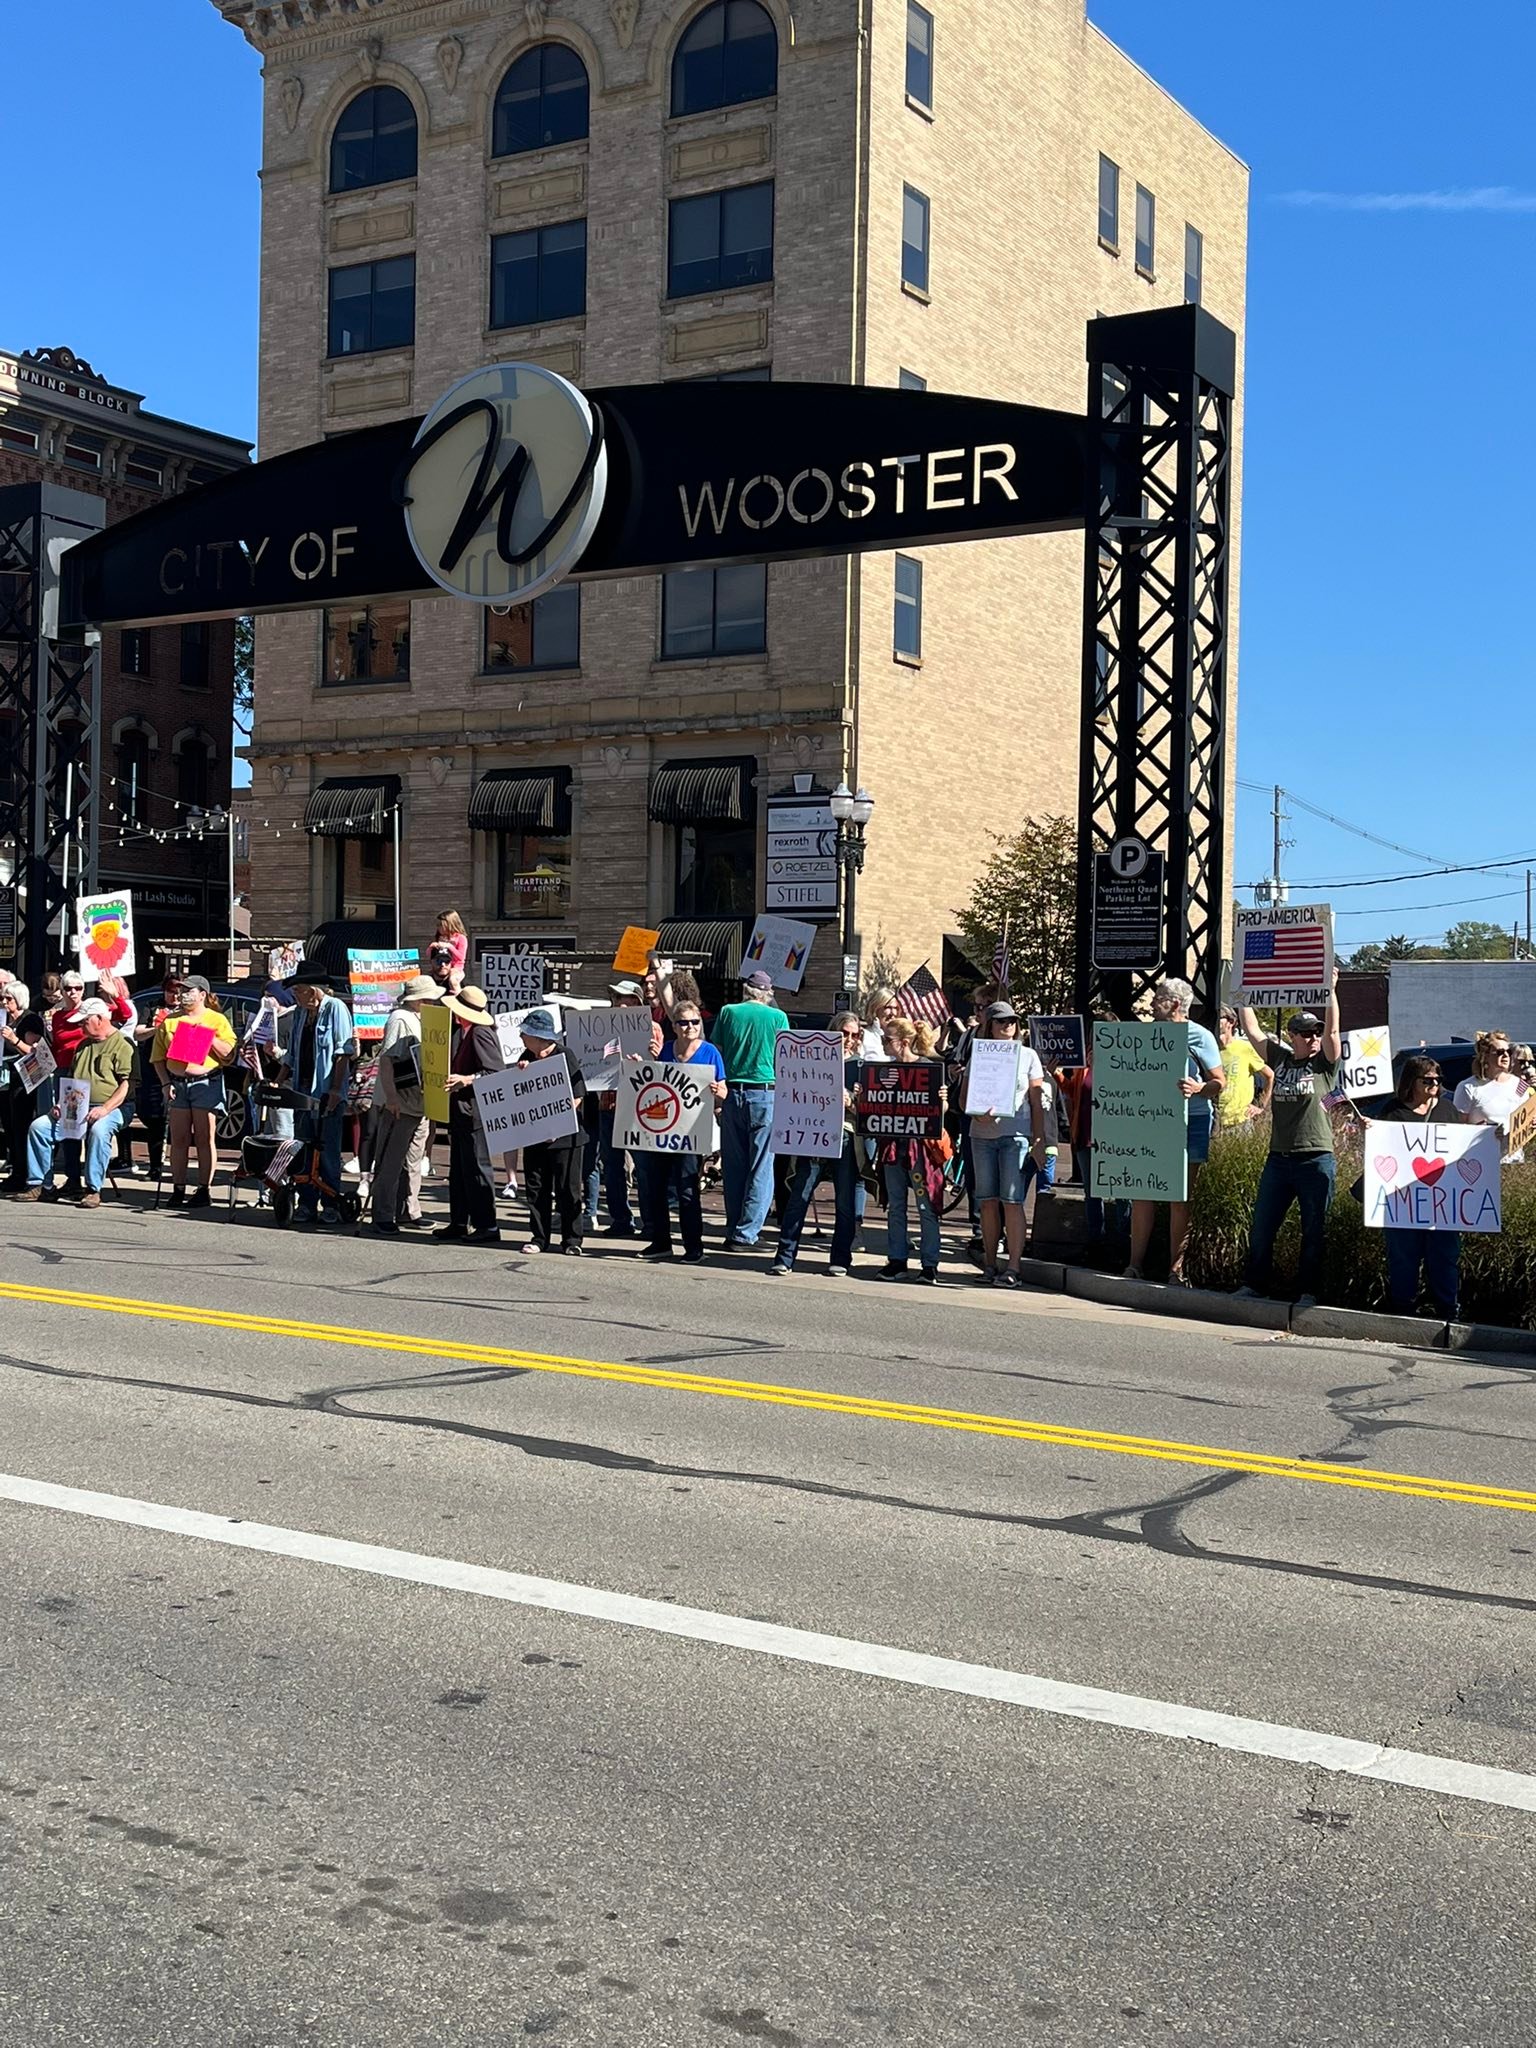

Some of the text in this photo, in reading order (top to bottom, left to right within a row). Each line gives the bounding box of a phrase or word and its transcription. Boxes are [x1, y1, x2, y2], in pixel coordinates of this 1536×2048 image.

[0, 363, 124, 412] DOWNING BLOCK
[679, 443, 1019, 538] WOOSTER
[160, 526, 358, 595] CITY OF
[774, 836, 809, 847] rexroth
[785, 862, 833, 872] ROETZEL
[1120, 845, 1140, 872] P
[513, 877, 561, 886] HEARTLAND
[1099, 885, 1158, 895] Northeast Quad
[145, 891, 166, 904] Lash
[167, 893, 196, 906] Studio
[1105, 894, 1151, 903] Parking Lot
[1236, 907, 1316, 927] PRO-AMERICA
[386, 950, 410, 960] LOVE
[352, 960, 384, 973] BLM
[485, 956, 542, 973] BLACK
[361, 973, 406, 984] NO KINGS
[485, 973, 541, 989] LIVES
[484, 990, 537, 1001] MATTER
[1249, 989, 1331, 1006] ANTI-TRUMP
[486, 1001, 510, 1014] TO
[579, 1015, 606, 1039] NO
[1048, 1023, 1065, 1032] One
[1100, 1027, 1175, 1056] Stop the
[779, 1045, 839, 1061] AMERICA
[1110, 1055, 1168, 1073] Shutdown
[780, 1065, 834, 1086] fighting
[1338, 1065, 1378, 1091] INGS
[481, 1071, 565, 1106] THE EMPEROR
[629, 1065, 701, 1109] NO KINGS
[1098, 1085, 1131, 1098] Swear
[792, 1088, 832, 1111] kings
[867, 1090, 930, 1104] NOT HATE
[485, 1097, 572, 1133] HAS NO CLOTHES
[858, 1102, 940, 1116] MAKES AMERICA
[1101, 1102, 1136, 1117] Adelita
[788, 1116, 826, 1128] since
[866, 1115, 929, 1135] GREAT
[1512, 1107, 1527, 1133] NO
[624, 1131, 640, 1146] IN
[783, 1130, 830, 1148] 1776
[1401, 1123, 1449, 1154] WE
[1100, 1141, 1157, 1158] Release the
[1096, 1160, 1169, 1195] Epstein files
[1370, 1184, 1500, 1226] AMERICA
